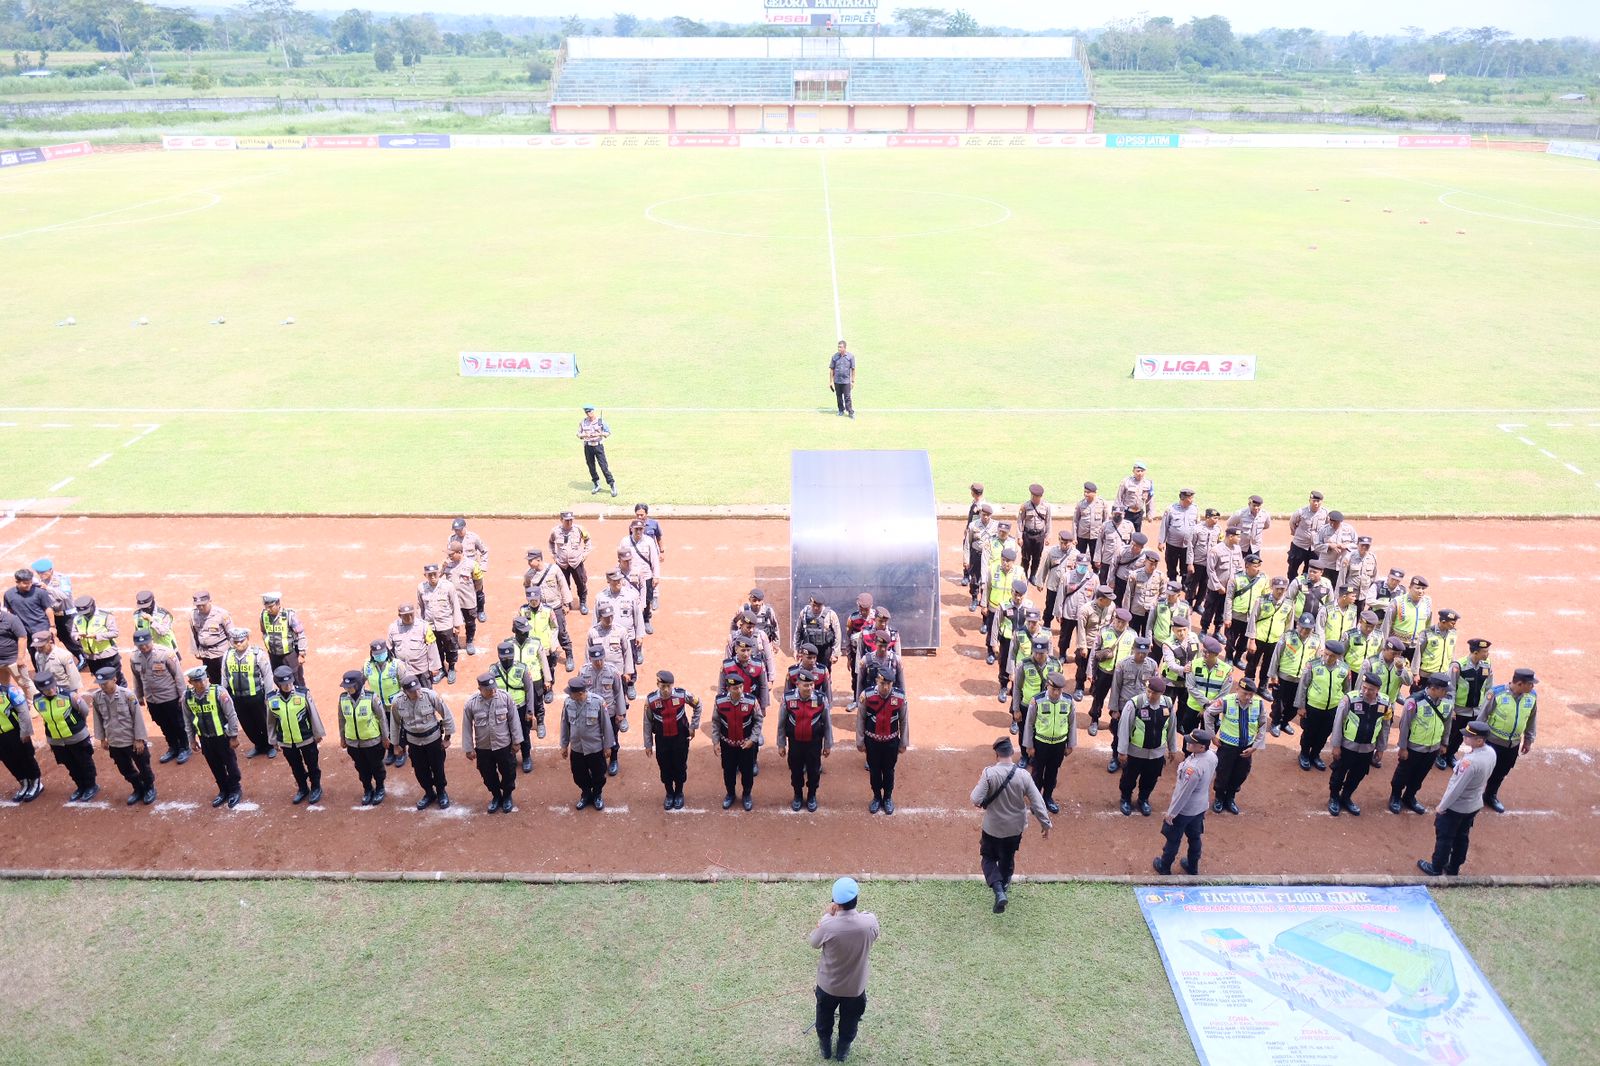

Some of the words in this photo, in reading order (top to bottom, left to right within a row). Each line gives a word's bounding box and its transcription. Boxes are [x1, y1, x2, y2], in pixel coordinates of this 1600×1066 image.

[773, 15, 808, 23] PSBI
[775, 136, 825, 144] LIGA
[1146, 135, 1170, 145] JATIM
[485, 358, 531, 369] LIGA
[540, 358, 552, 370] 3
[1162, 360, 1210, 372] LIGA
[1219, 360, 1233, 372] 3
[1200, 892, 1273, 903] TACTICAL
[1275, 892, 1324, 903] FLOOR
[1326, 891, 1371, 903] GAME
